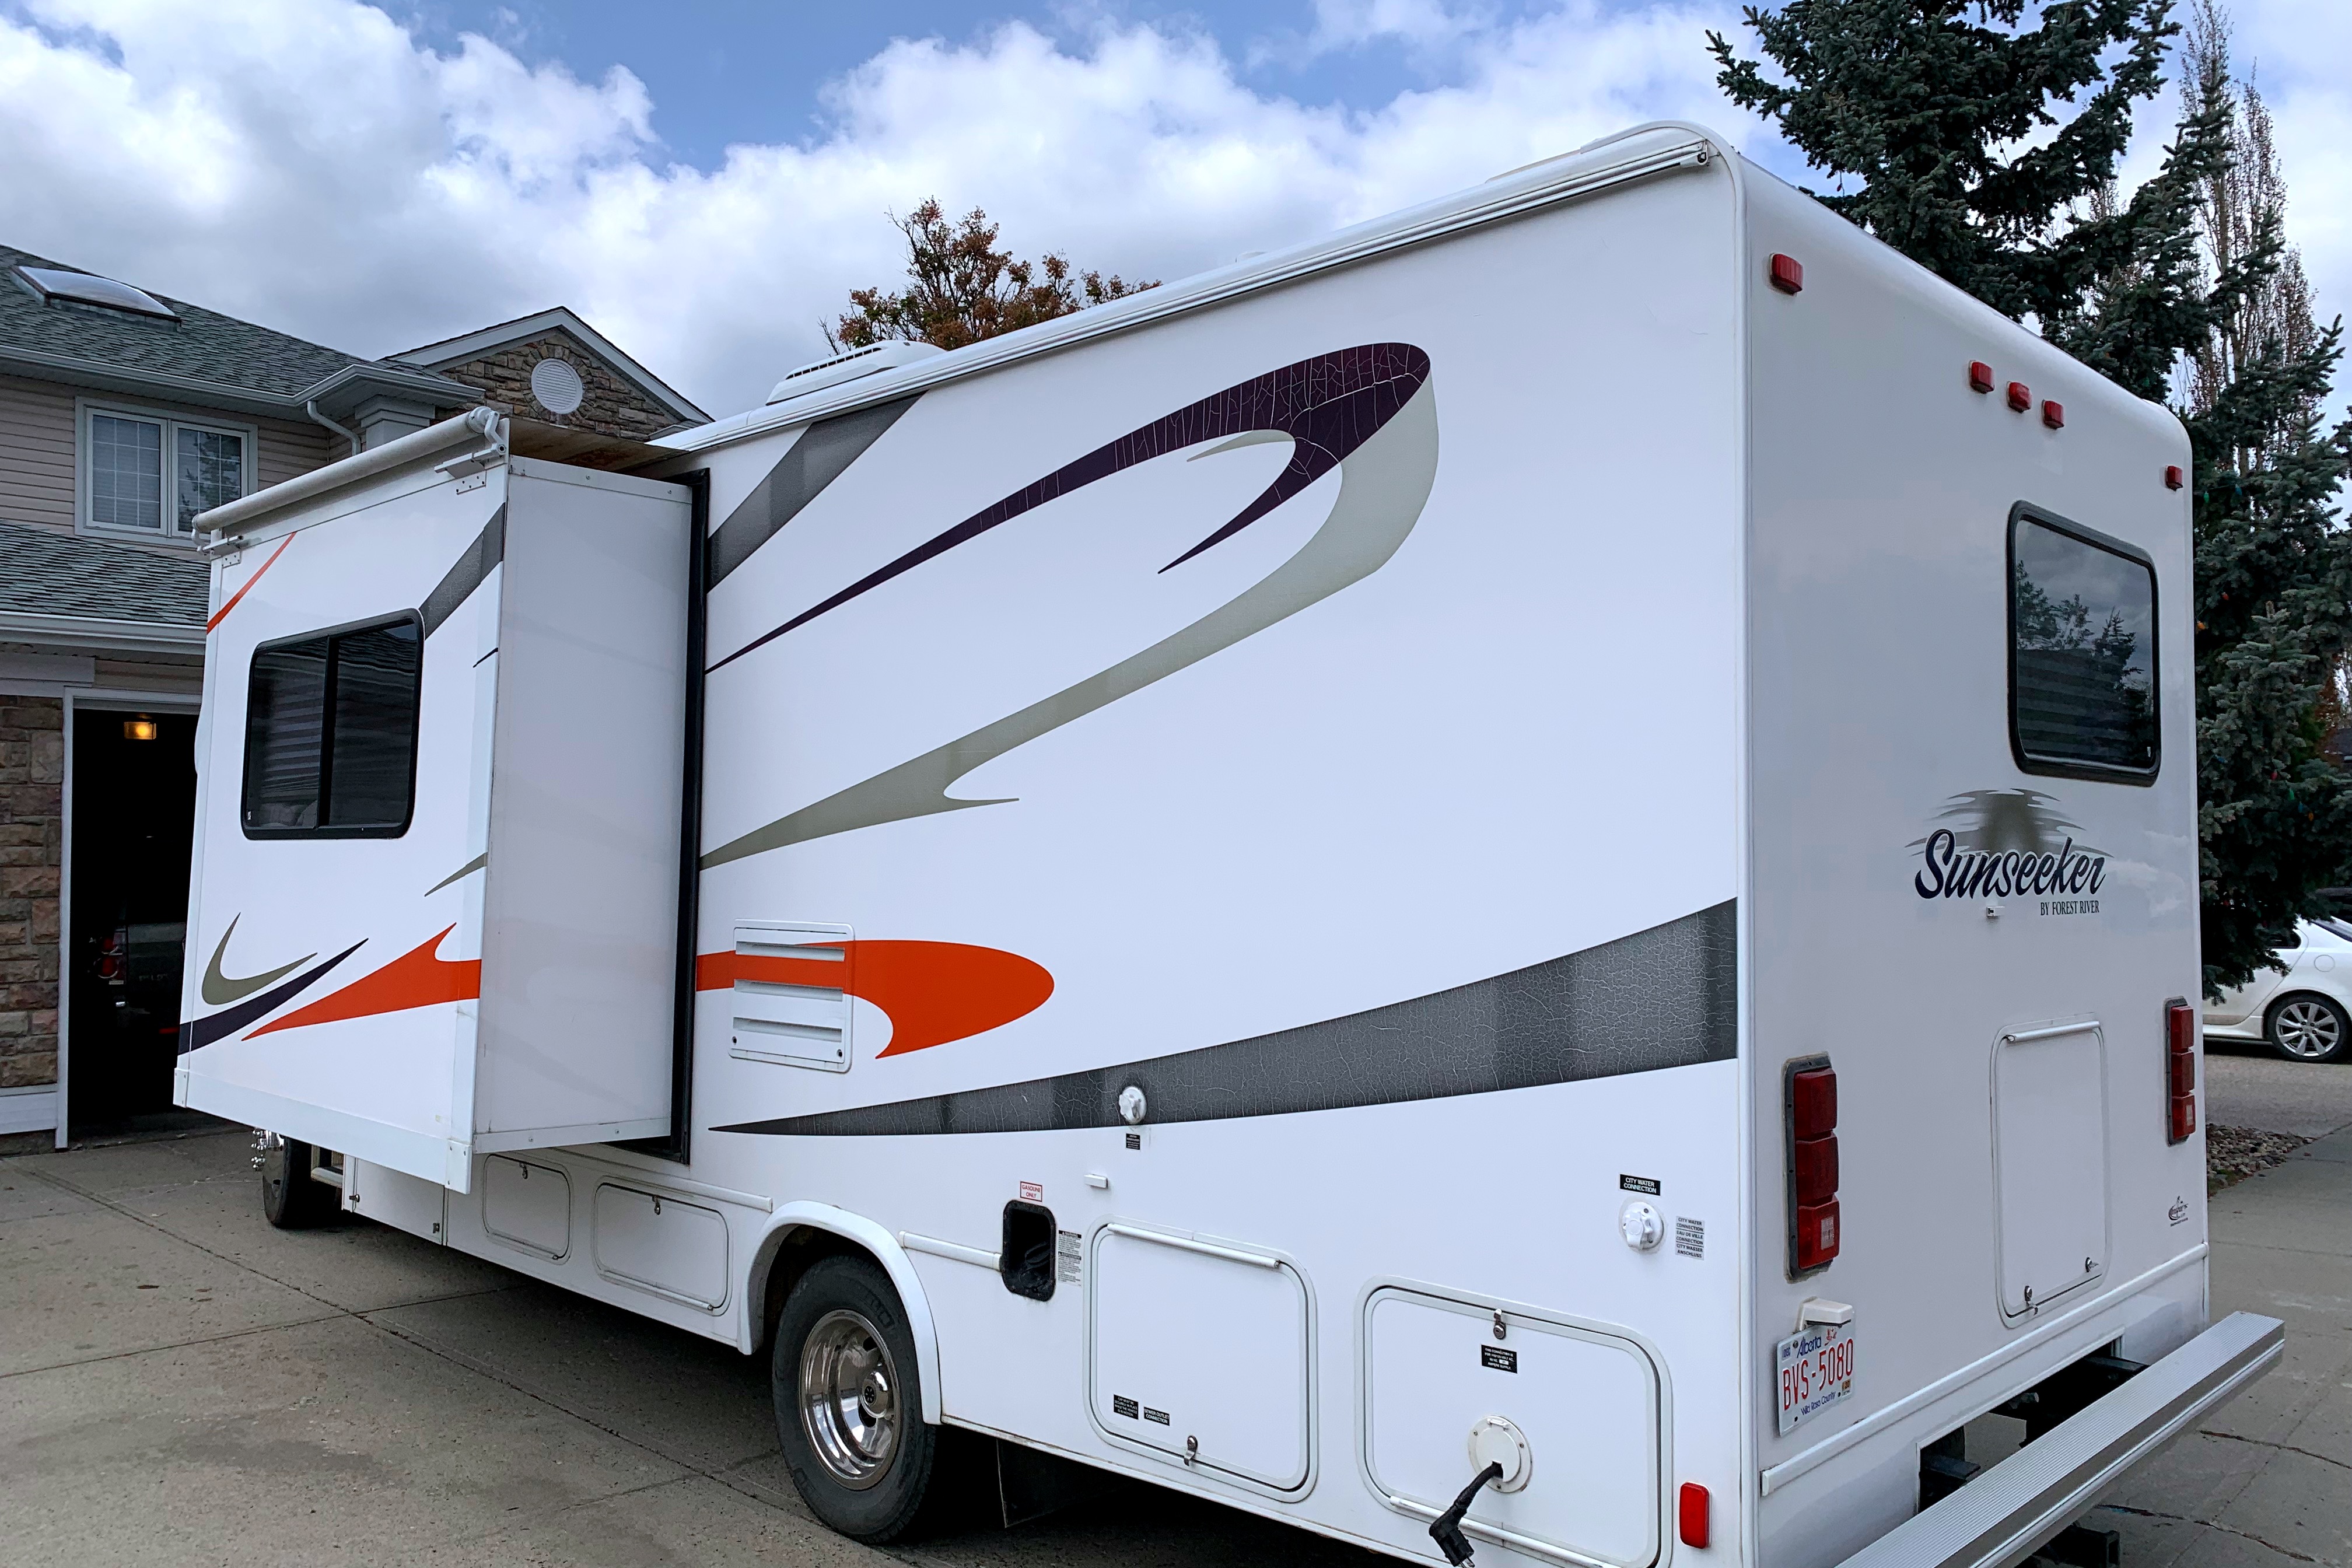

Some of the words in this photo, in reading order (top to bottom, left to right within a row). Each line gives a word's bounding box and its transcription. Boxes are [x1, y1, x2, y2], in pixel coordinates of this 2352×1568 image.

[1915, 829, 2106, 899] Sunseeker
[2041, 902, 2050, 916] BY
[2052, 901, 2078, 915] FOREST
[2080, 900, 2099, 914] RIVER
[1021, 1184, 1041, 1193] GASOLINE
[1623, 1182, 1657, 1194] CONNECTION
[1637, 1179, 1655, 1188] WATER
[1676, 1223, 1703, 1232] CONNECTION
[1676, 1236, 1703, 1245] CONNECTION
[1677, 1250, 1702, 1258] ANSCHLUSS
[1797, 1336, 1822, 1359] Alberta
[1783, 1338, 1853, 1410] BVS-5080
[1821, 1391, 1836, 1405] Country
[1146, 1413, 1168, 1424] CONNECTION
[1156, 1412, 1170, 1420] OUTLET
